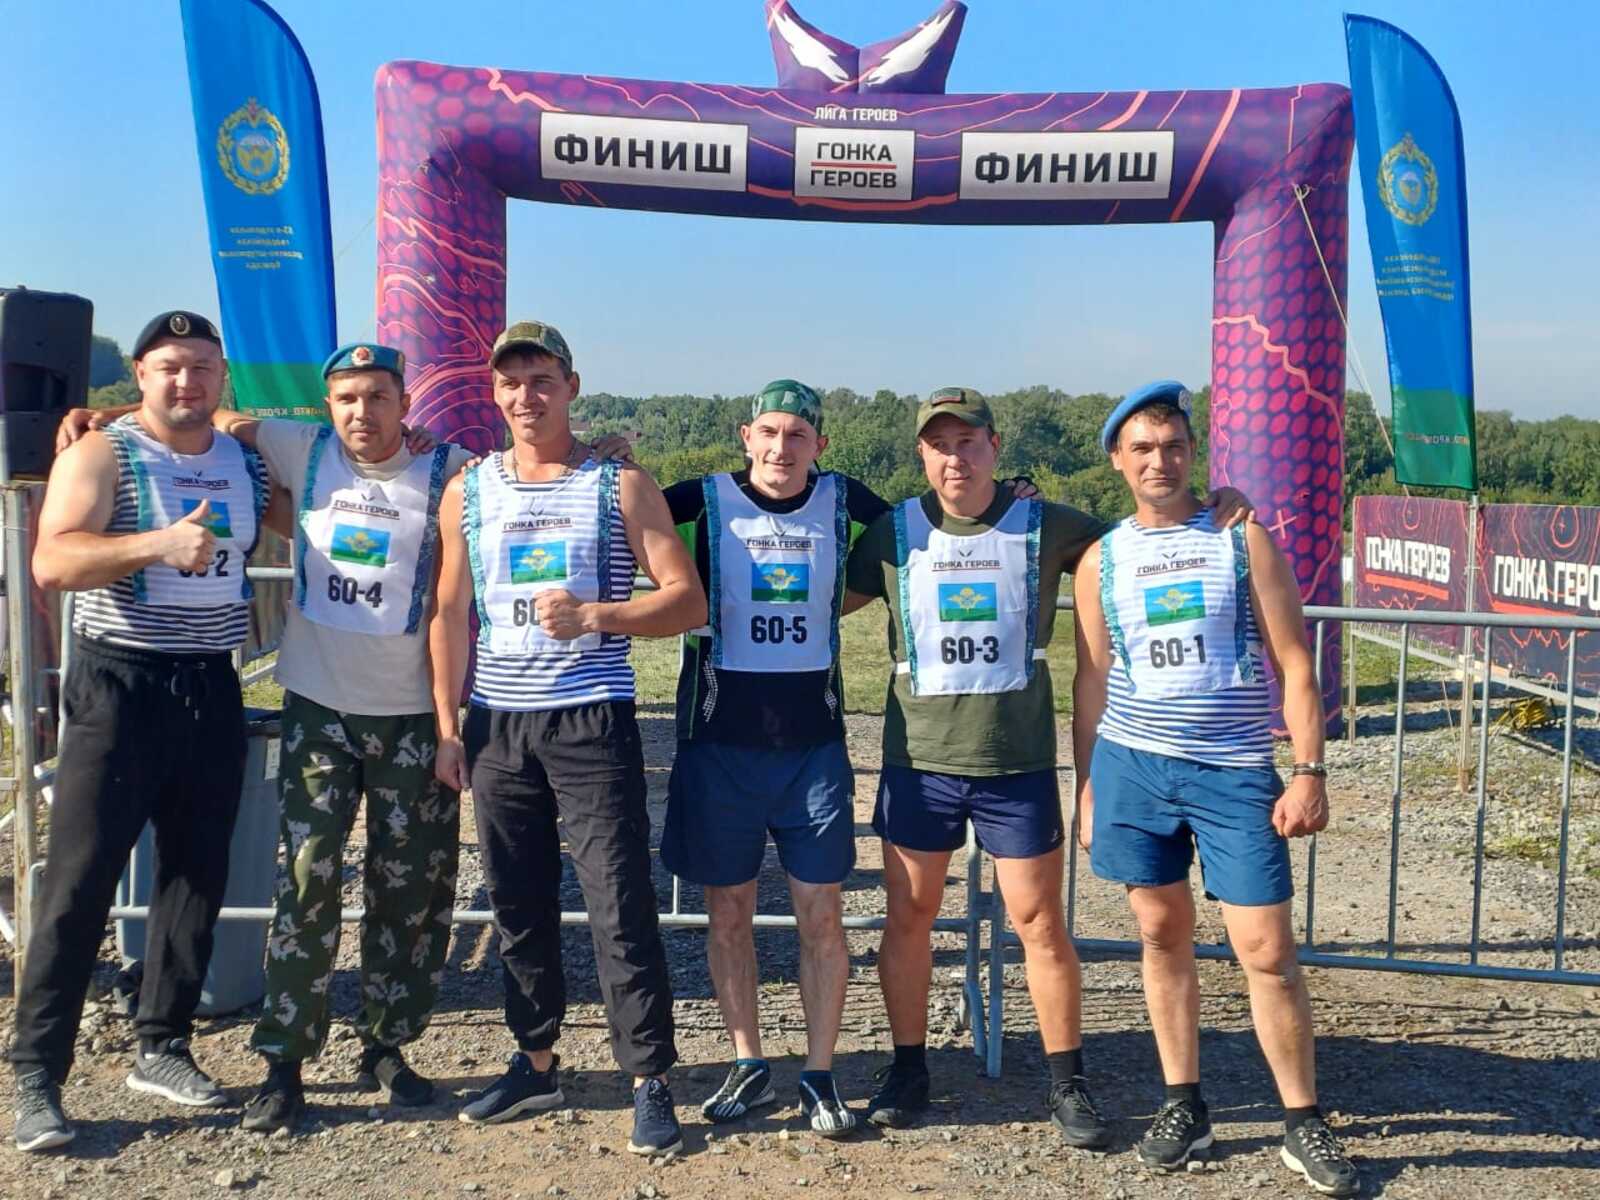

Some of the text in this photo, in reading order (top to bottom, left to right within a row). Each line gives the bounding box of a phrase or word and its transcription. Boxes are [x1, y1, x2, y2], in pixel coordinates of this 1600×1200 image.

[814, 107, 898, 122] ЛИГА ГЕРОЕВ
[554, 133, 731, 174] ФИНИШ
[817, 142, 892, 161] ГОНКА
[810, 170, 897, 188] ГЕРОЕВ
[975, 152, 1157, 183] ФИНИШ
[504, 517, 571, 530] ГОНКА ГЕРОЕВ
[746, 539, 776, 547] ГОНКА
[933, 559, 1001, 569] ГОНКА ГЕРОЕВ
[1137, 557, 1207, 574] ГОНКА ГЕРОЕВ
[1494, 555, 1548, 602] ГОНКА
[328, 574, 383, 608] 60-4
[751, 615, 808, 644] 60-5
[941, 635, 1000, 664] 60-3
[1150, 633, 1207, 669] 60-1
